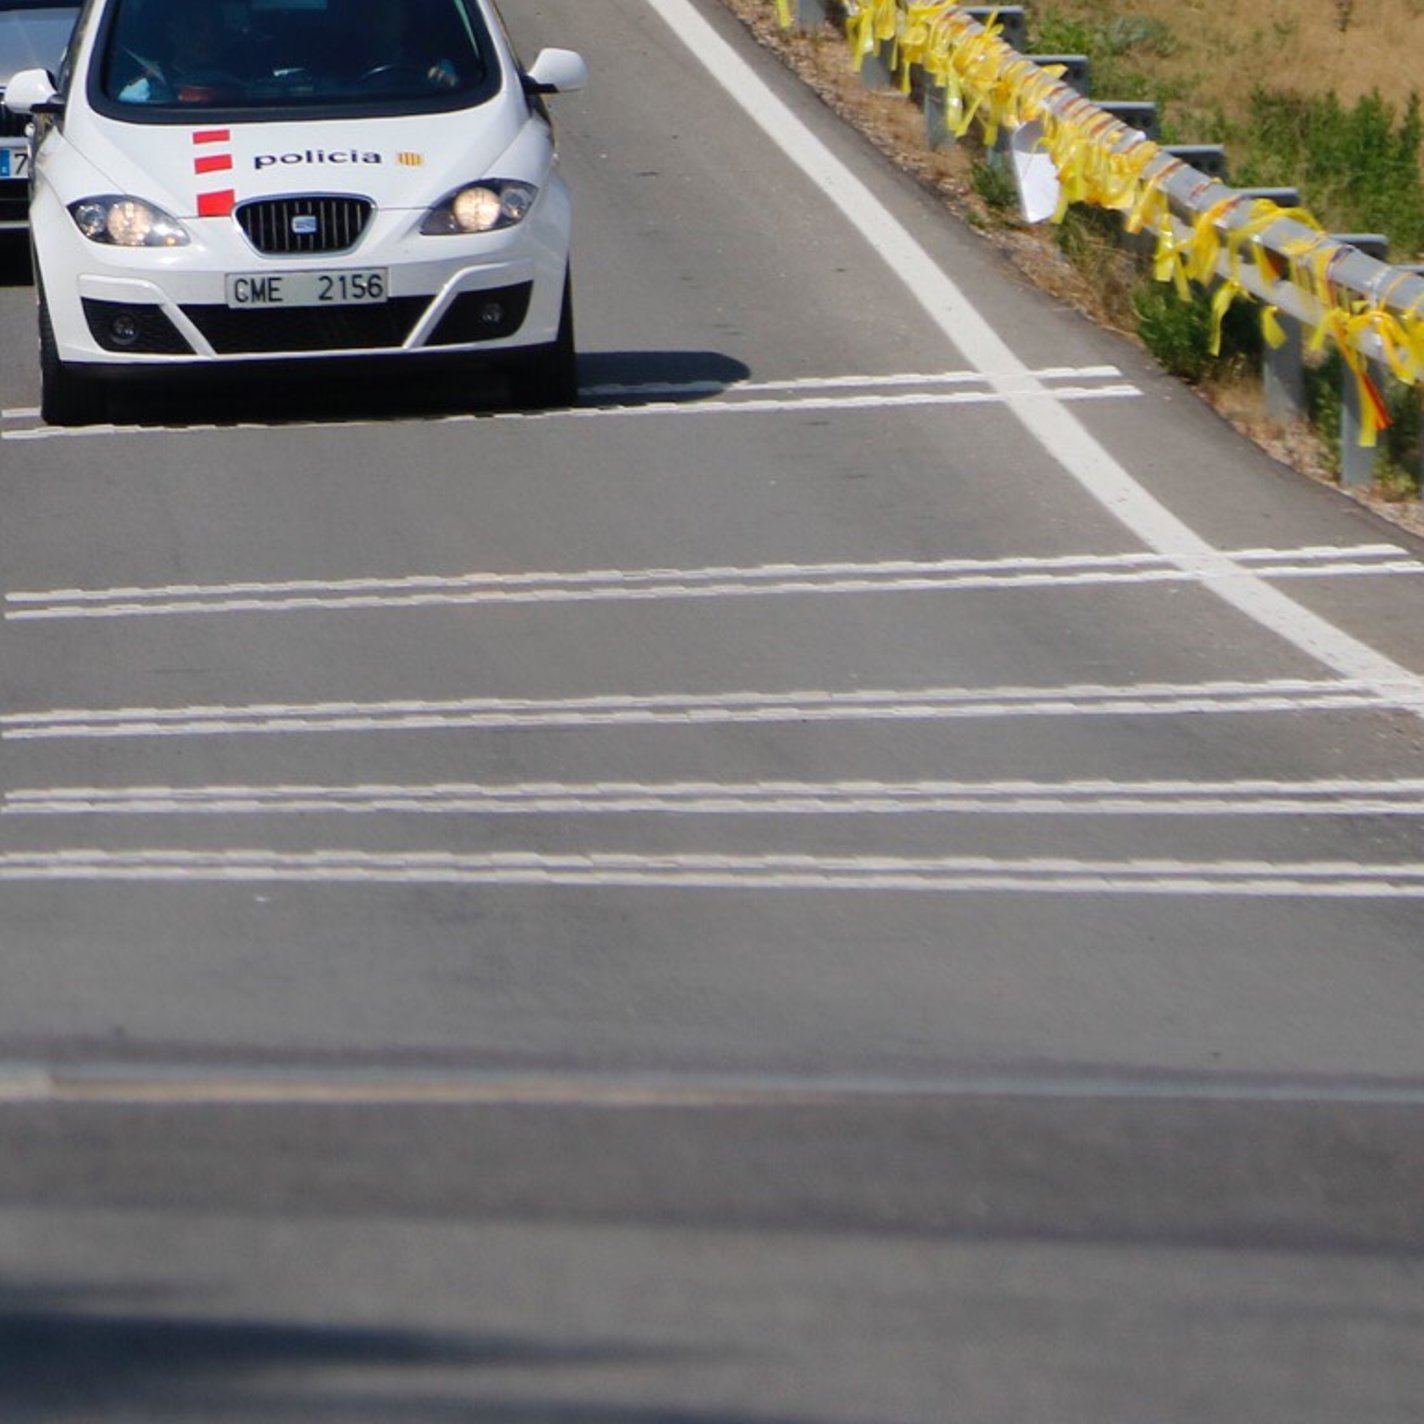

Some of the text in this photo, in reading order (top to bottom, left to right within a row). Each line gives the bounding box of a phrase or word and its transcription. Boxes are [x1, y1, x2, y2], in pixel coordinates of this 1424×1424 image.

[253, 149, 382, 170] policia
[233, 274, 384, 303] CME 2156
